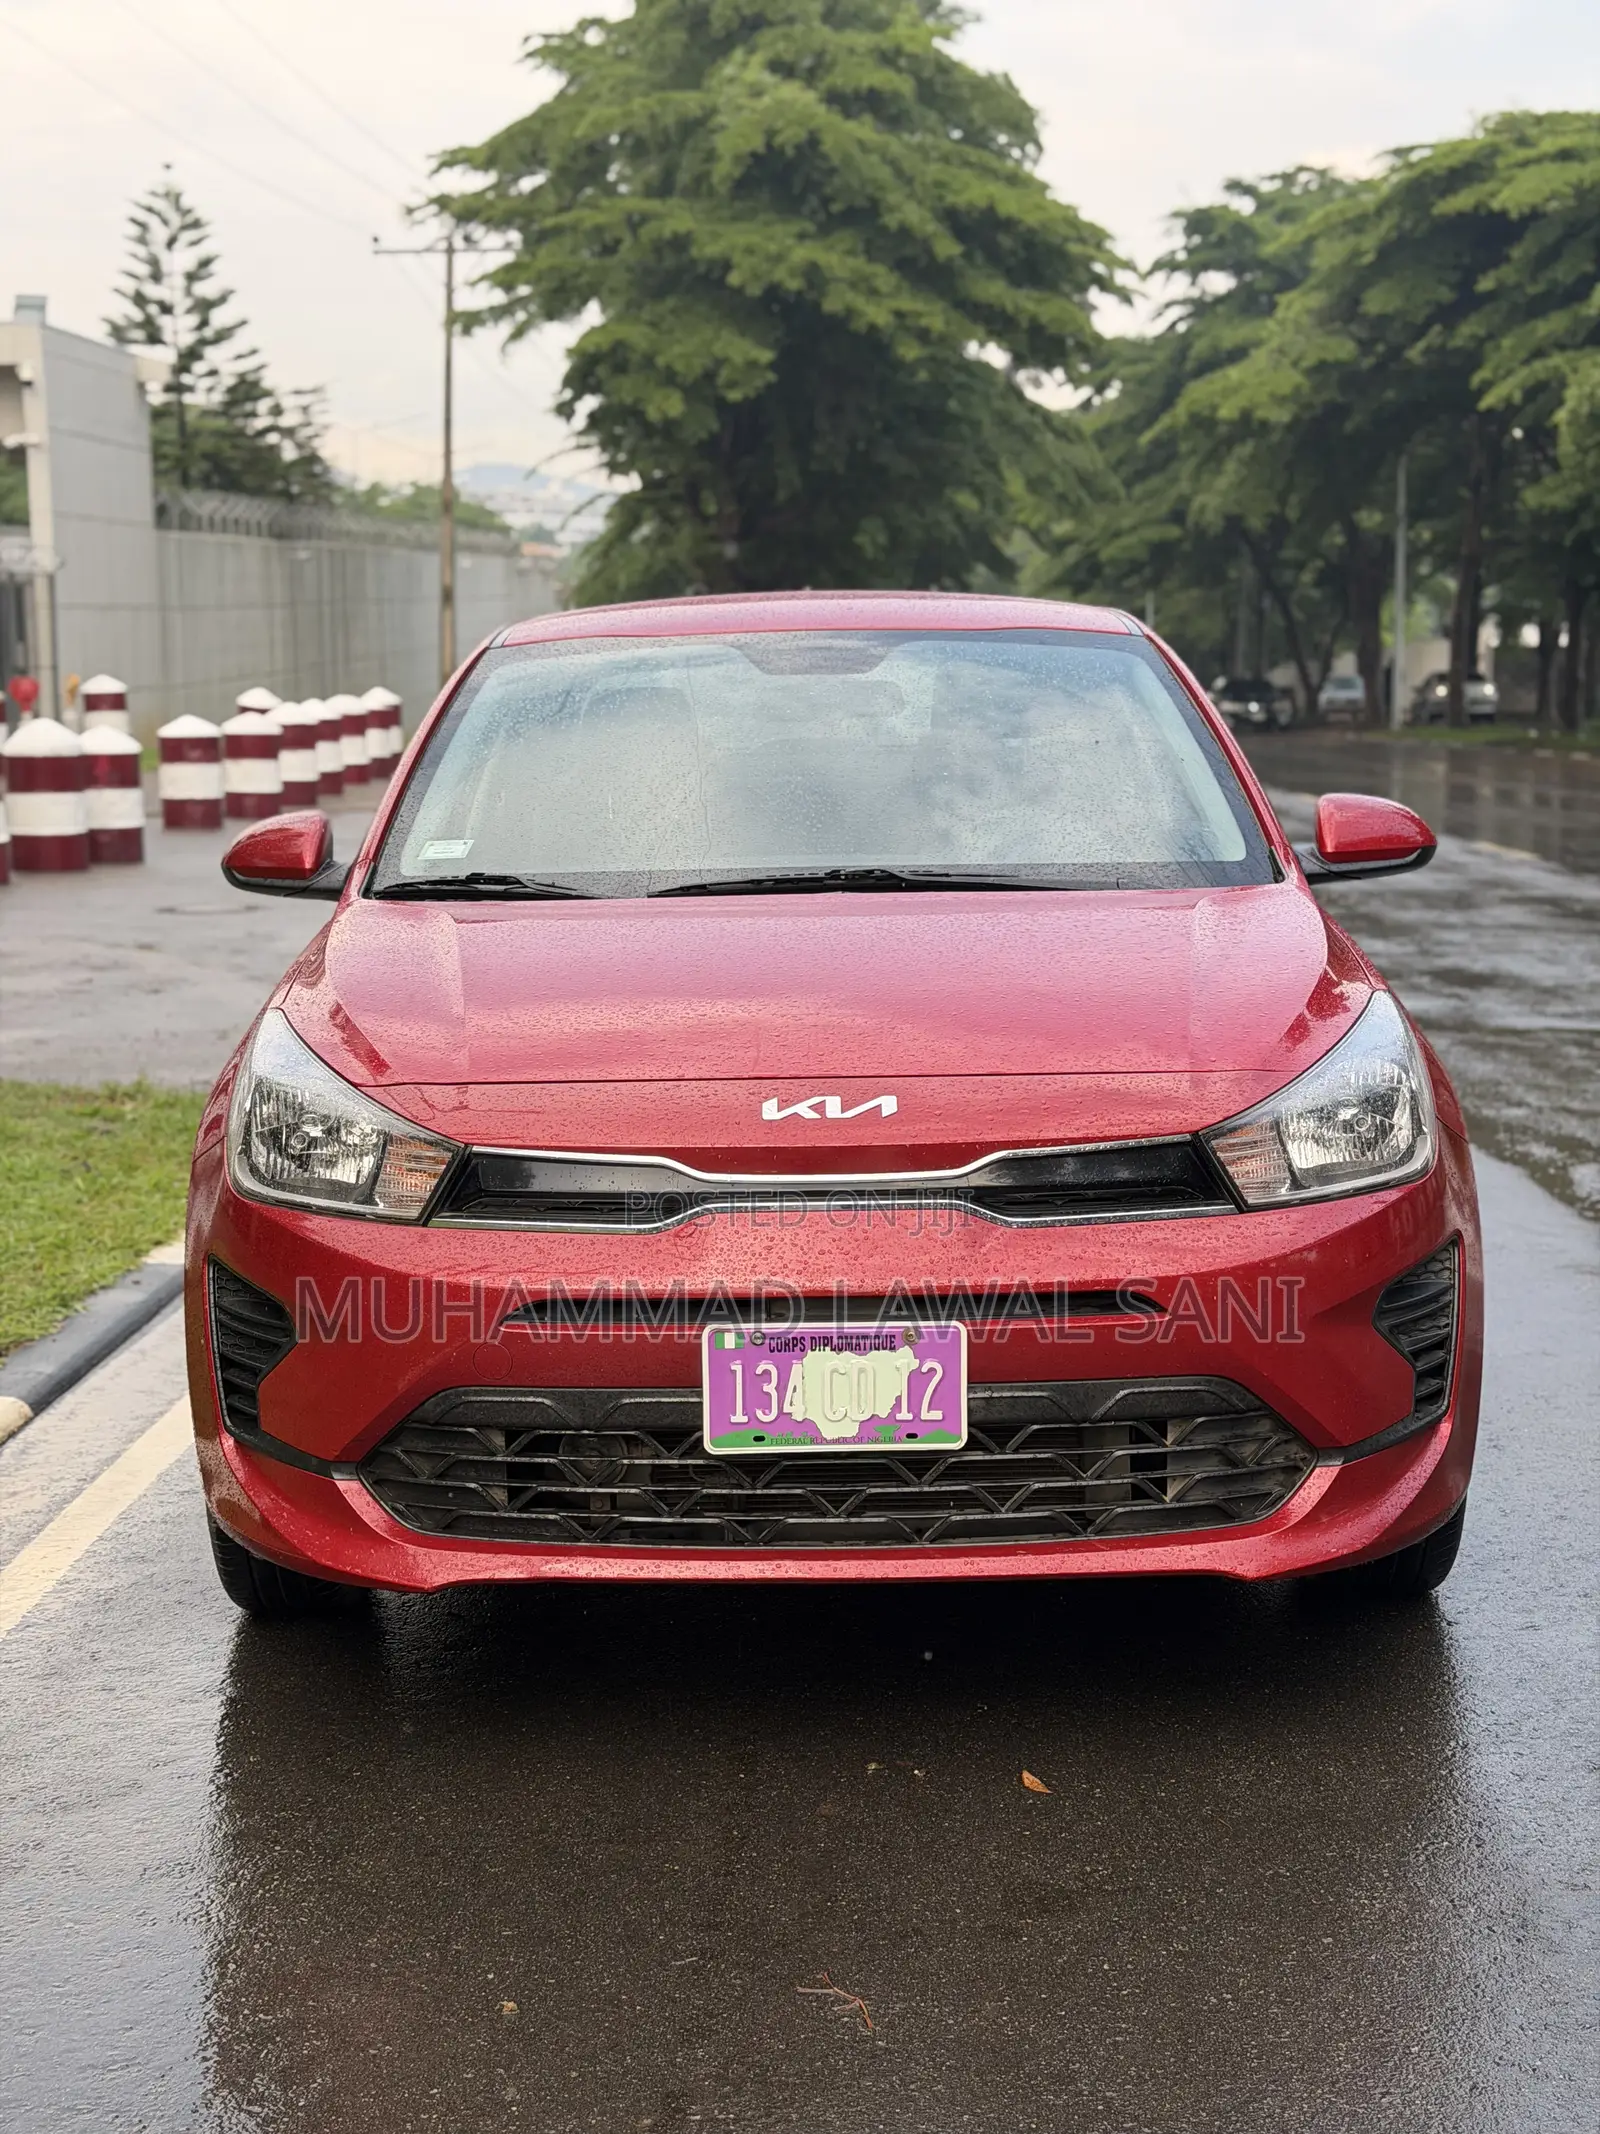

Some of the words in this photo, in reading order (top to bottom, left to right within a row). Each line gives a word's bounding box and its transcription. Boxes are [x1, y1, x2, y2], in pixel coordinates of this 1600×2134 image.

[762, 1095, 898, 1120] KIA
[768, 1335, 807, 1353] CORPS
[809, 1334, 897, 1353] DIPLOMATIQUE
[729, 1360, 806, 1423] 134
[823, 1360, 876, 1422] CD
[895, 1359, 944, 1421] 12
